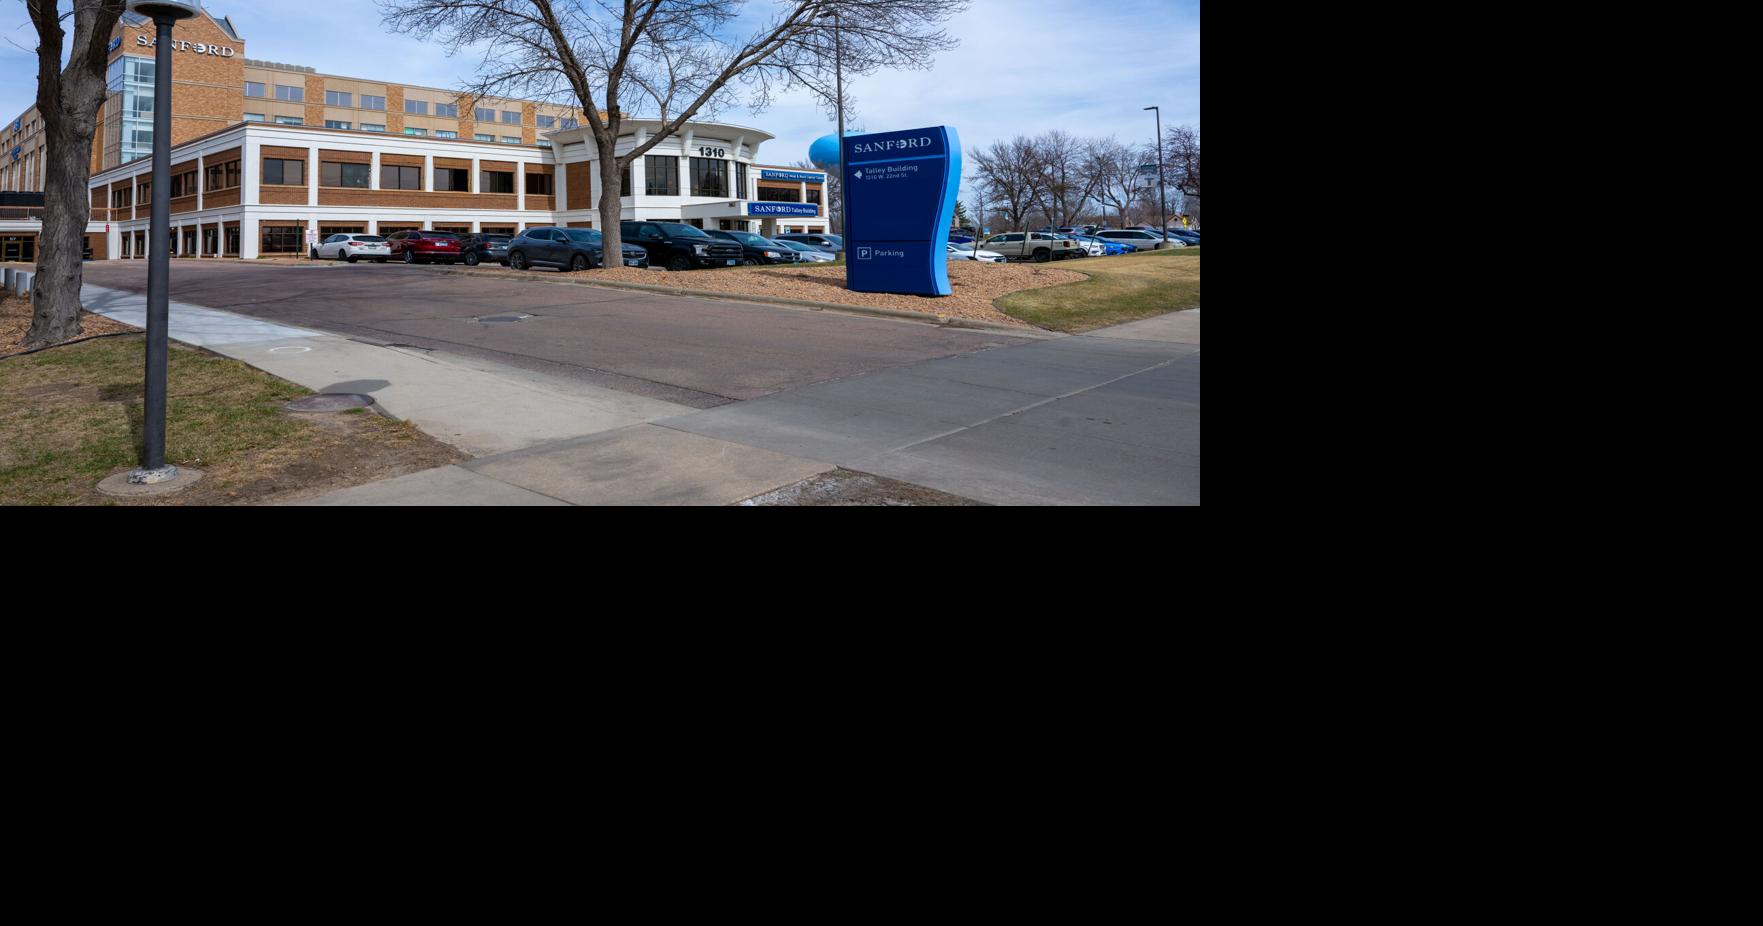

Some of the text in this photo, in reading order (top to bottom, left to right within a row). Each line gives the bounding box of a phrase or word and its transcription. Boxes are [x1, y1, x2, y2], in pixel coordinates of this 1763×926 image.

[853, 136, 932, 153] SANFORD
[698, 146, 725, 158] 1310
[887, 165, 919, 173] Building
[754, 205, 791, 213] SANFORD
[861, 249, 905, 258] P Parking
